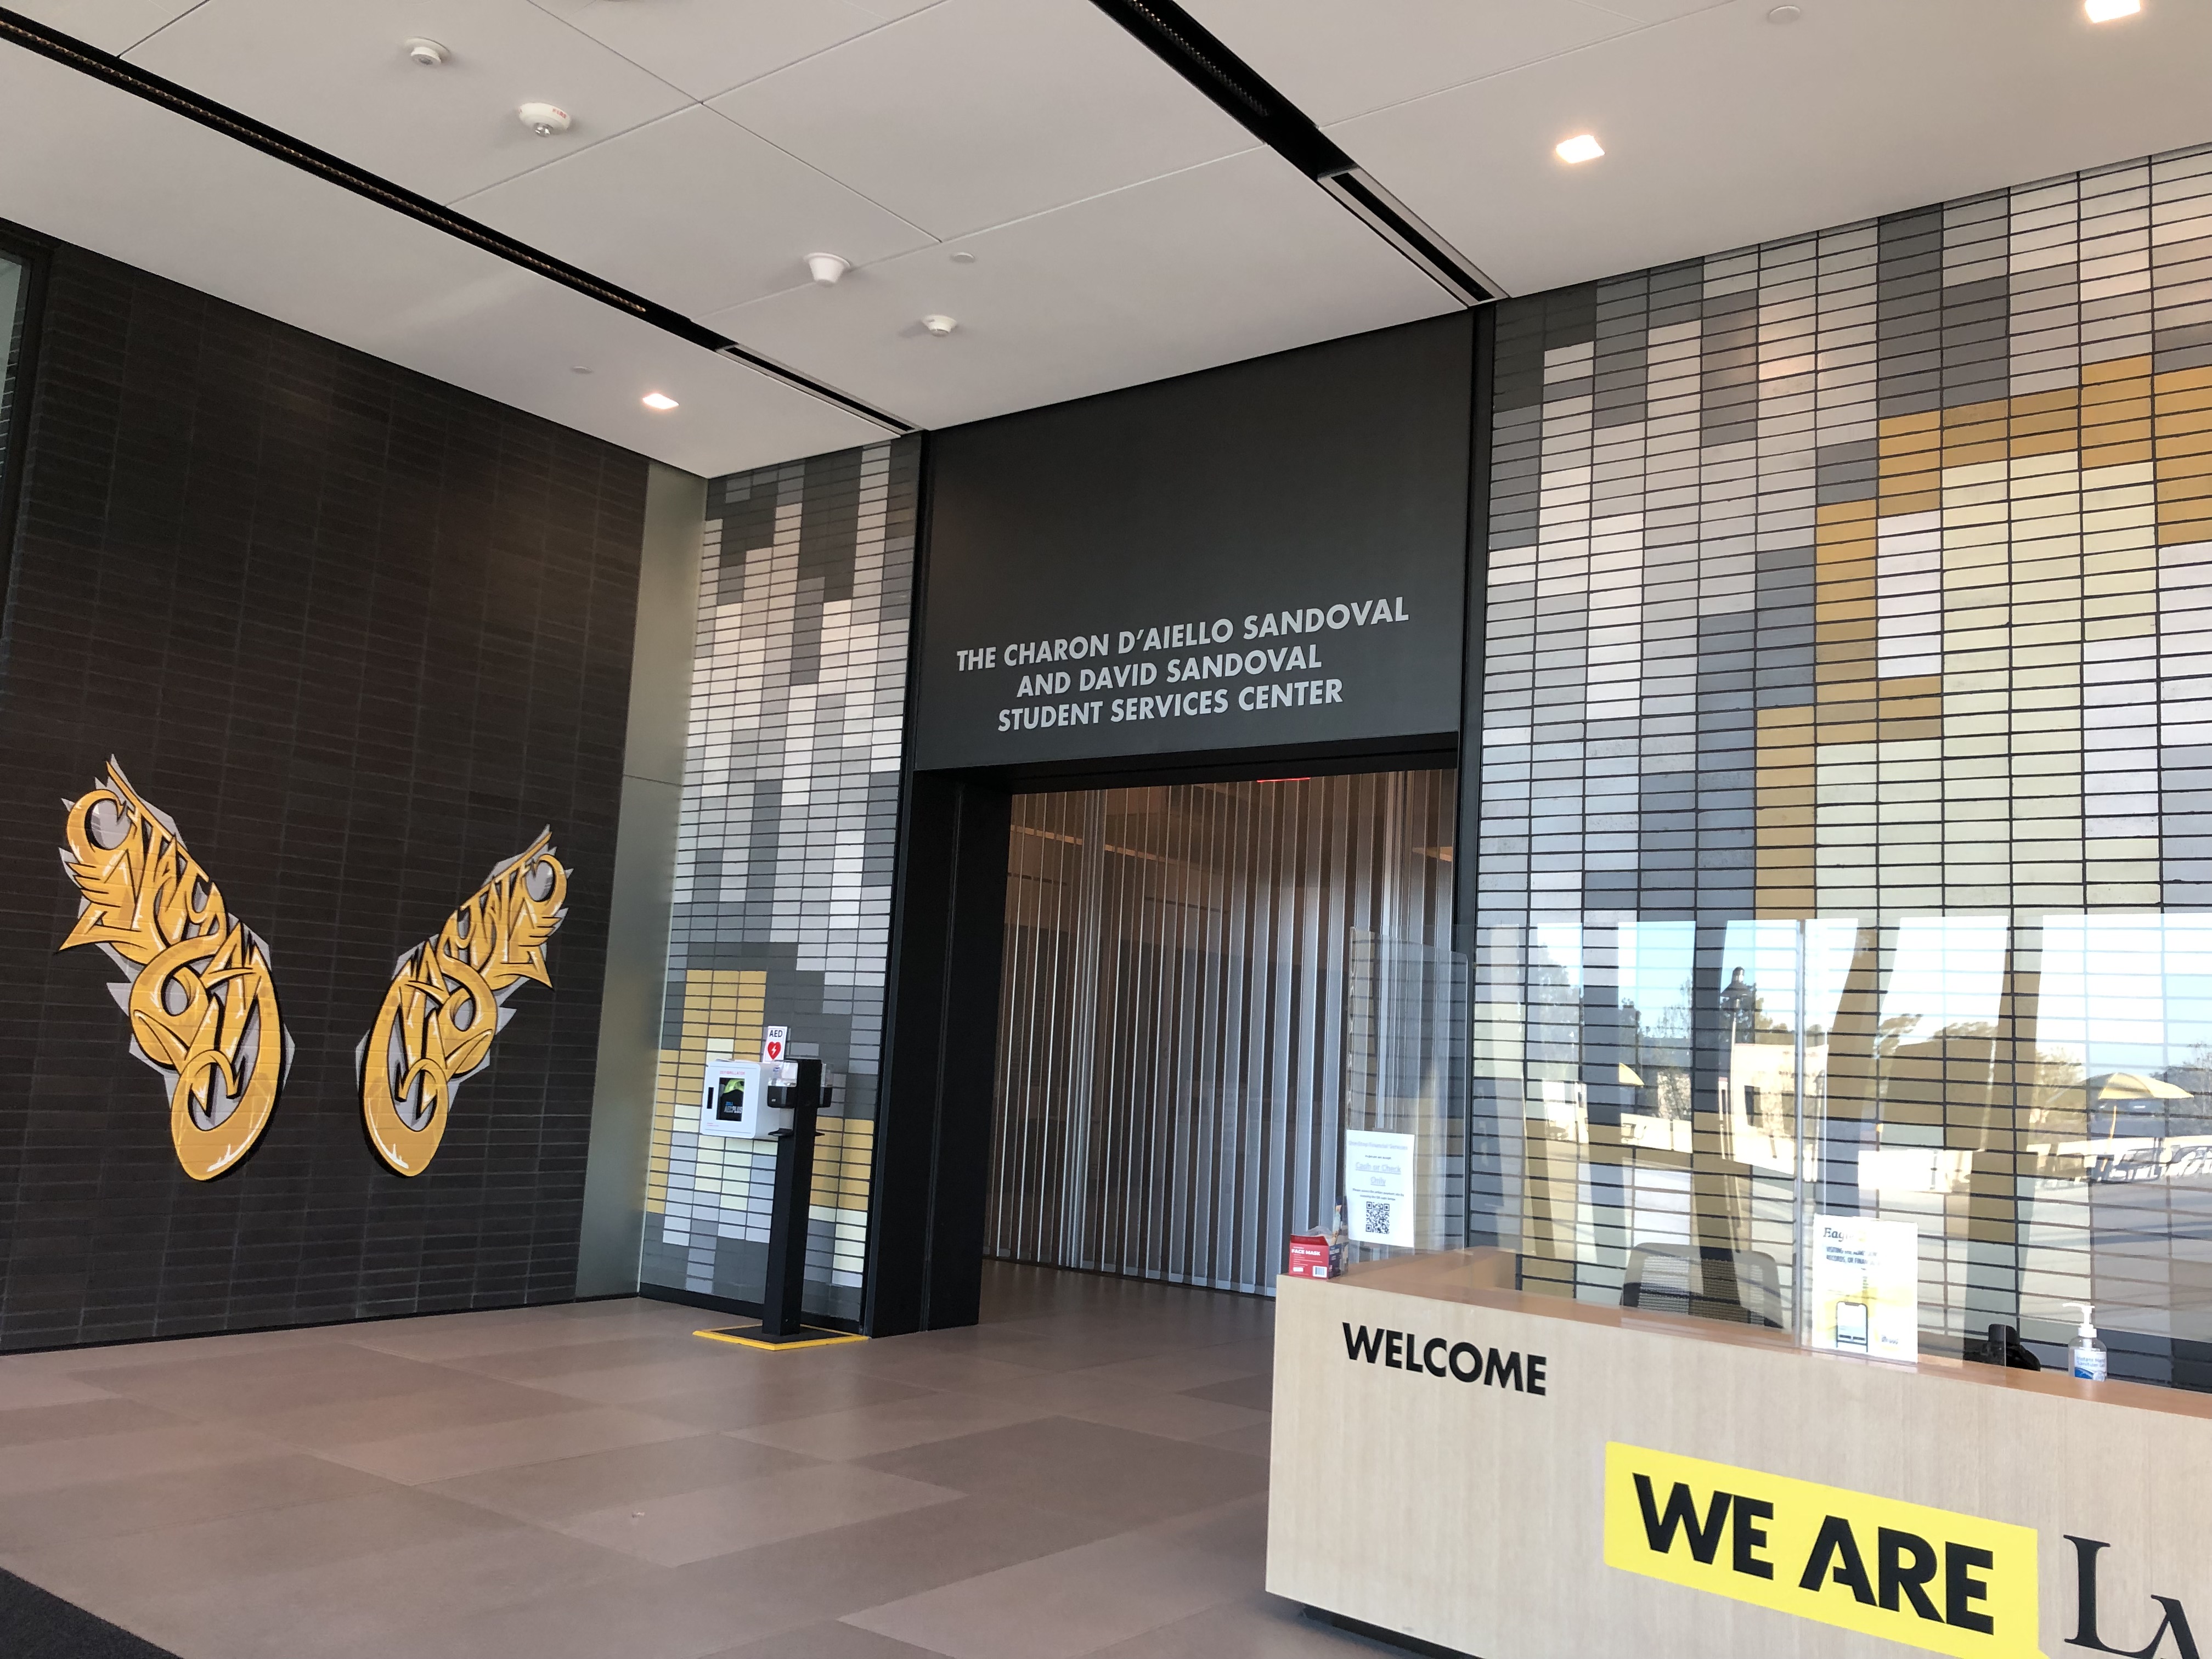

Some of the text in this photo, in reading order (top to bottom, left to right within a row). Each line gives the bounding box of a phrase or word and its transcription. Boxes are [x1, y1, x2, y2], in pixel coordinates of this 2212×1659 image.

[957, 596, 1409, 672] THE CHARON D'AIELLO SANDOVAL
[1017, 644, 1322, 697] AND DAVID SANDOVAL
[998, 679, 1343, 732] STUDENT SERVICES CENTER
[769, 1030, 783, 1038] AED
[1342, 1322, 1547, 1396] WELCOME
[1633, 1473, 1994, 1635] WE ARE
